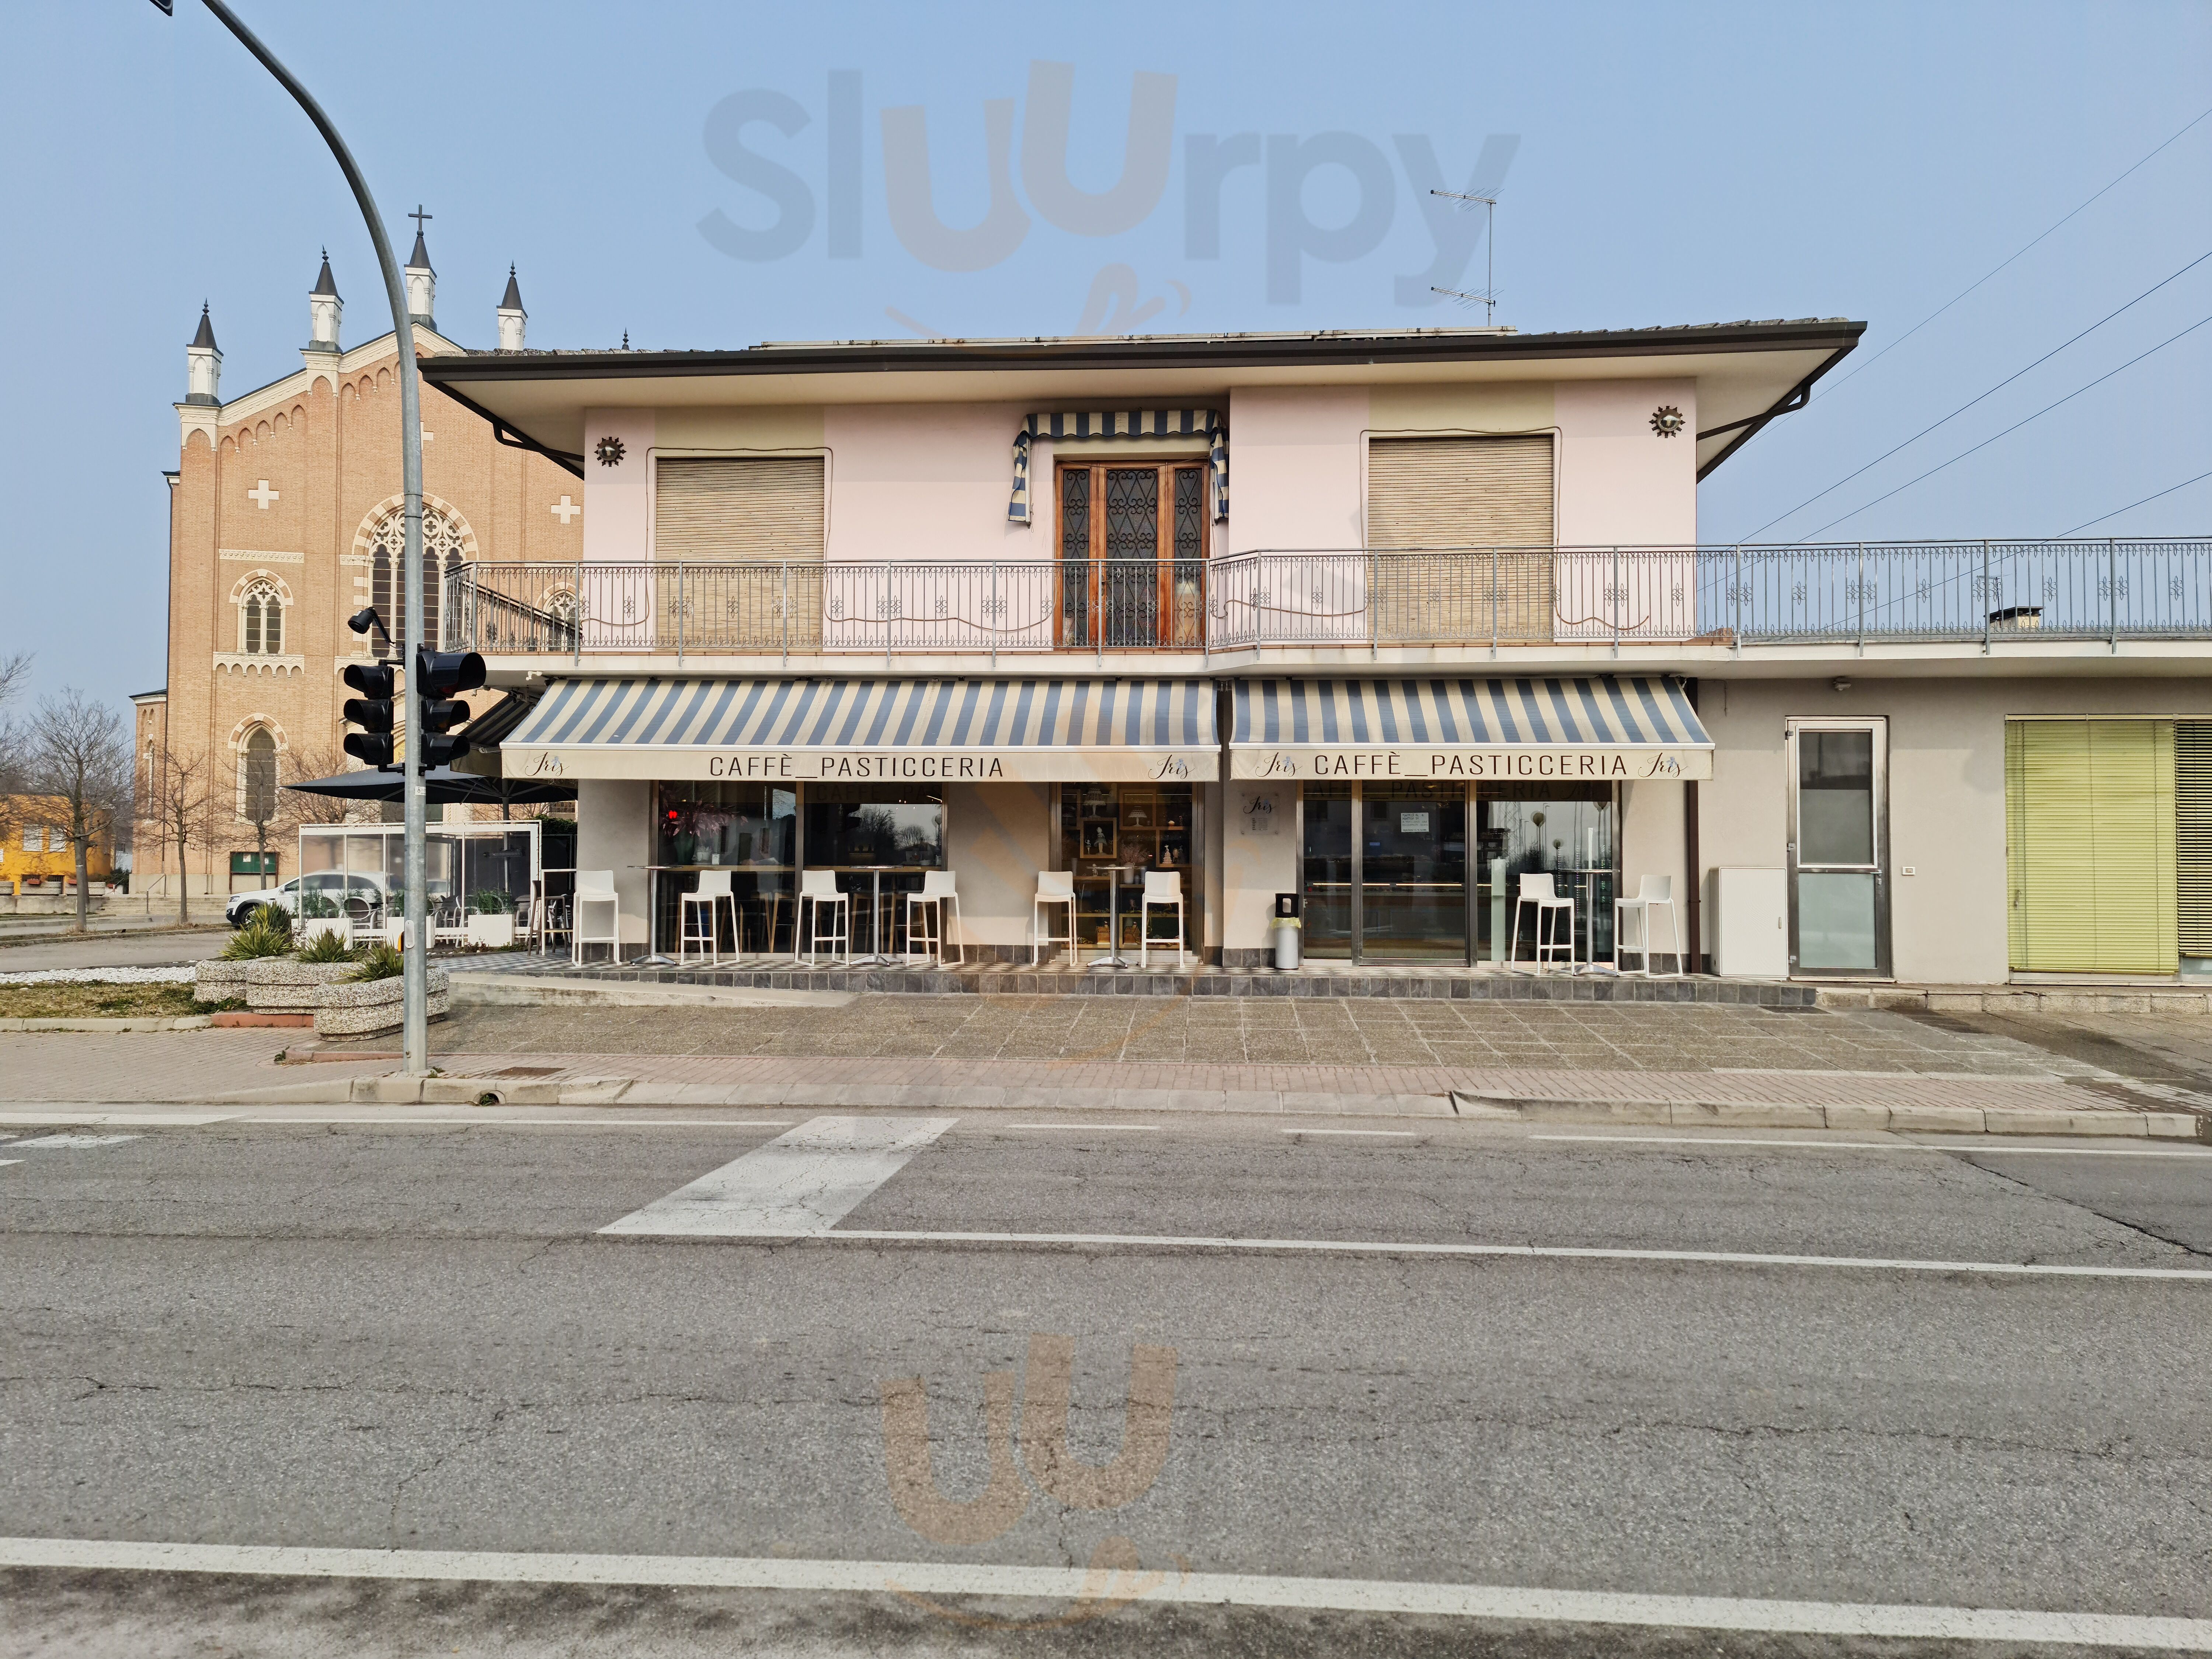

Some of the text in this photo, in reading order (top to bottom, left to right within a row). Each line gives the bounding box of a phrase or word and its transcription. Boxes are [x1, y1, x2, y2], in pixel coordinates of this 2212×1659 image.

[525, 752, 570, 776] Iris
[822, 757, 1003, 777] PASTICCERIA
[1148, 754, 1195, 779] Iris
[1255, 752, 1303, 777] Iris
[1432, 755, 1627, 775] PASTICCERIA
[1638, 752, 1688, 778] Iris
[1243, 796, 1276, 814] Iris
